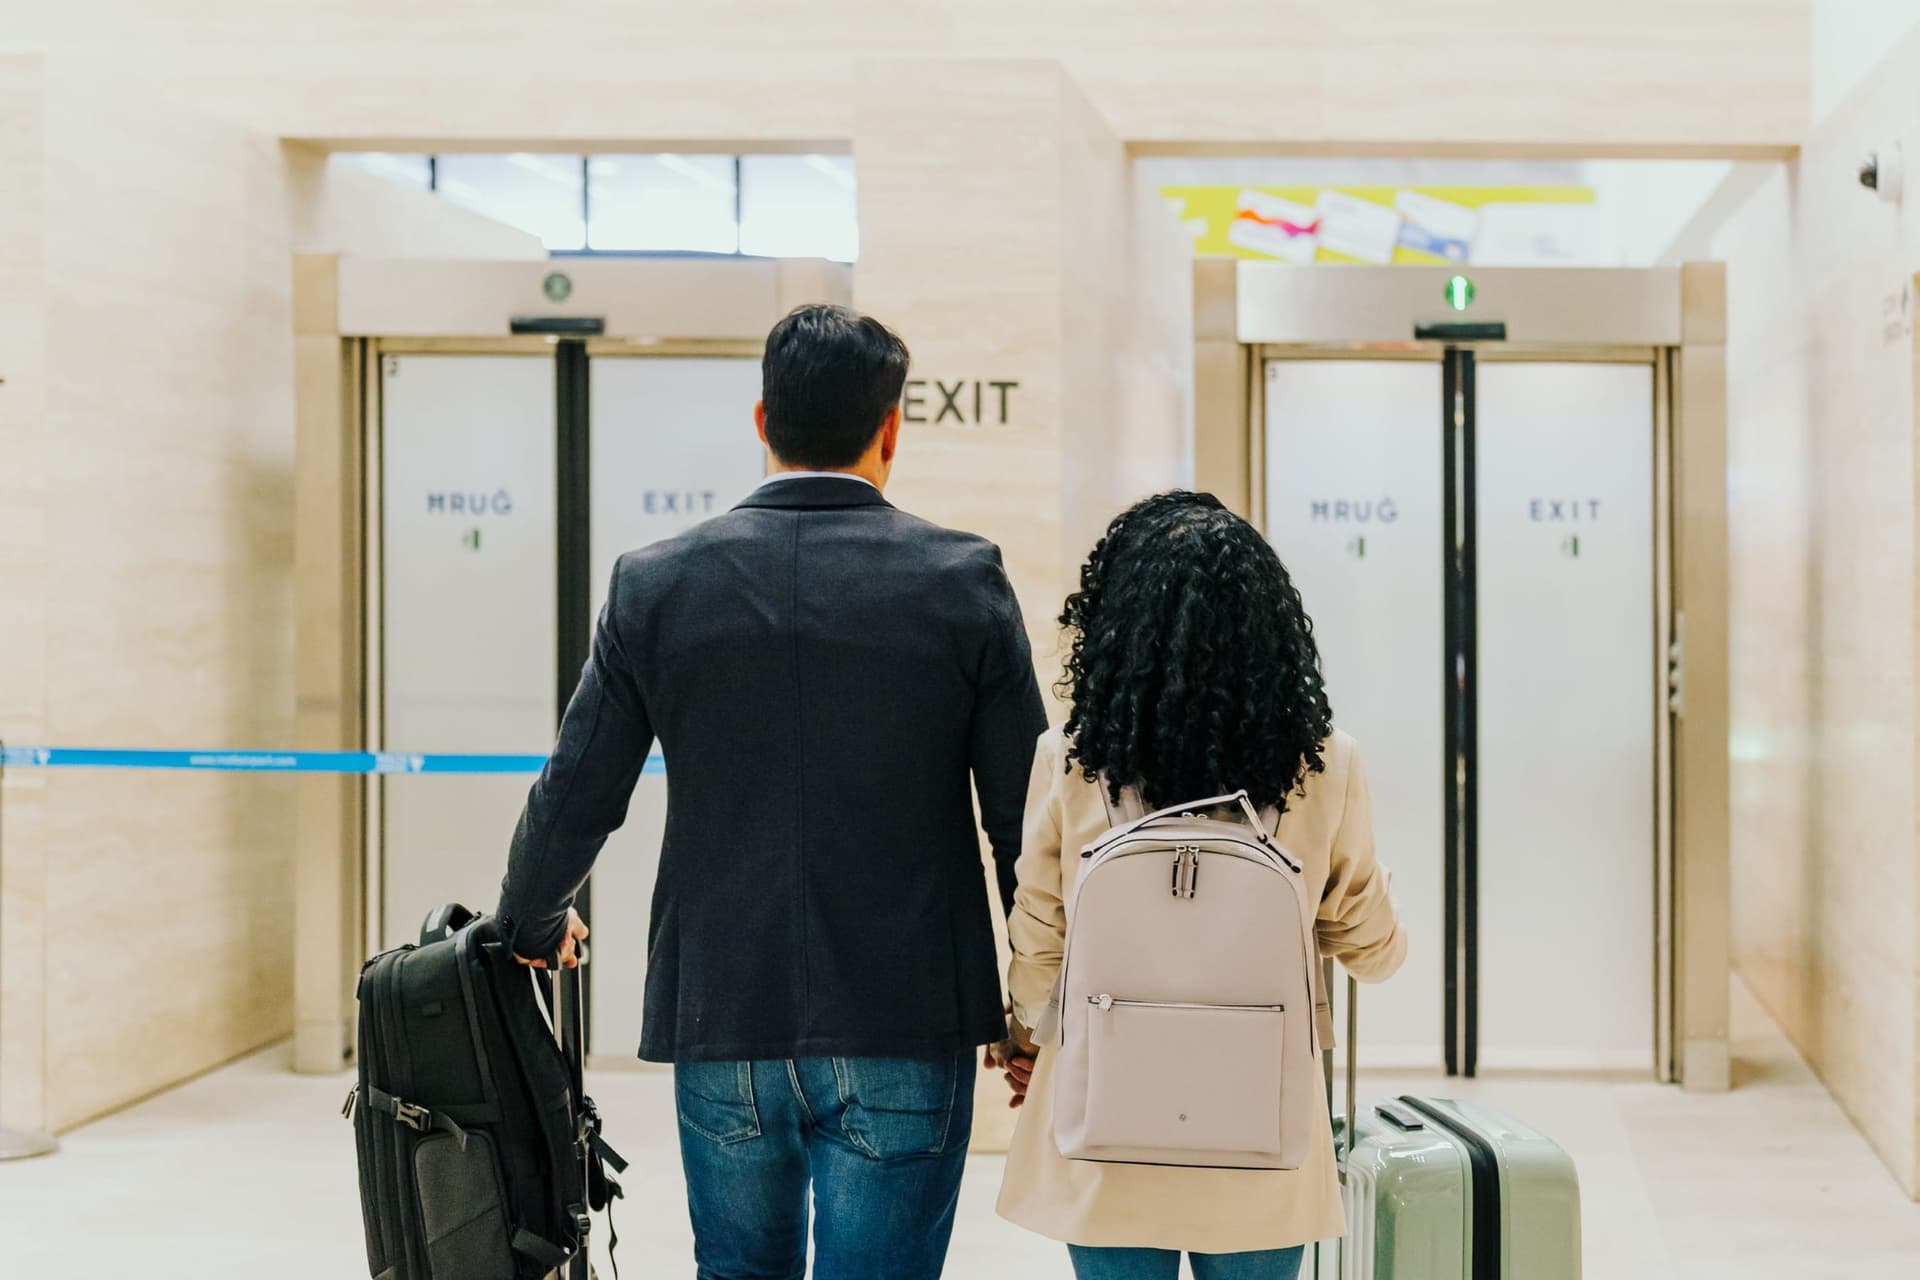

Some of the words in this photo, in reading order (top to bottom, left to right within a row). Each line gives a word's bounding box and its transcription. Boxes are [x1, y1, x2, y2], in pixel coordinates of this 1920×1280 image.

[902, 380, 1019, 423] EXIT
[643, 491, 715, 513] EXIT
[1529, 499, 1602, 521] EXIT
